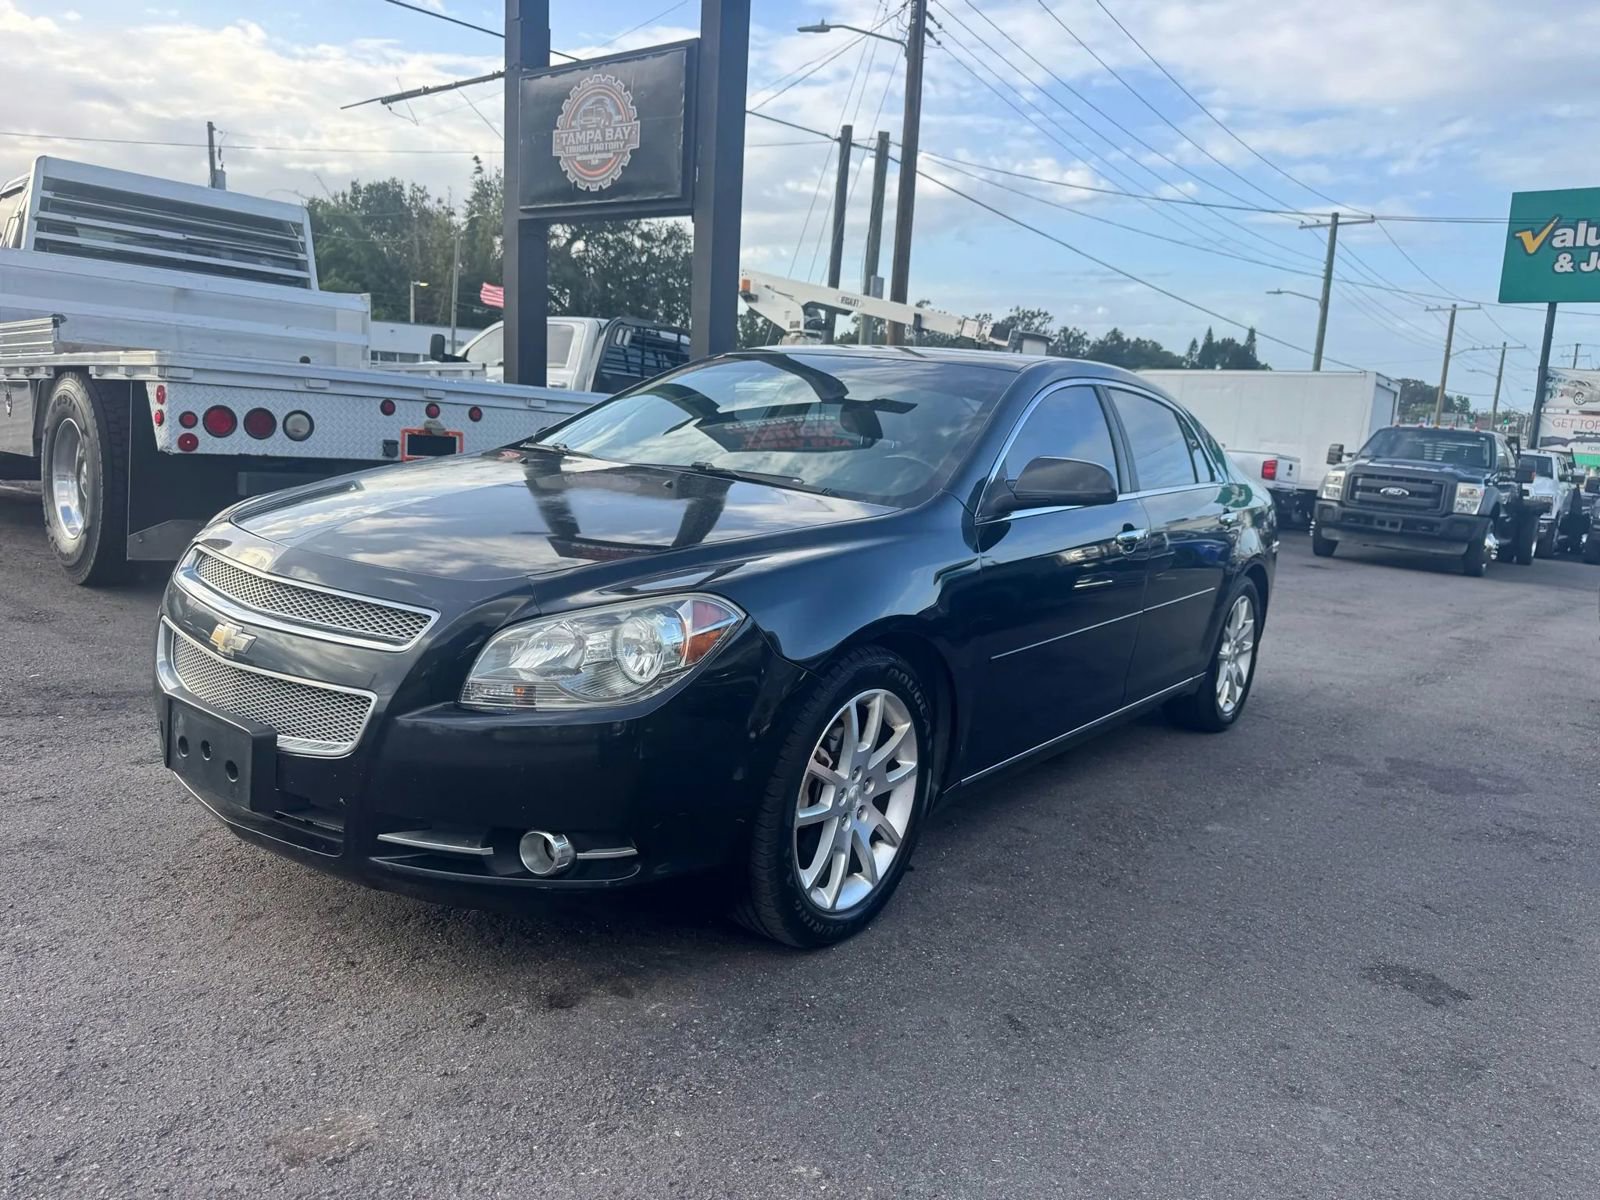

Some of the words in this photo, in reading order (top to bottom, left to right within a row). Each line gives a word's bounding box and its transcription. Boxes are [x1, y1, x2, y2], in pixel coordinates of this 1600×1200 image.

[561, 129, 602, 145] TAMPA
[605, 126, 631, 141] BAY
[1553, 252, 1574, 273] &
[1580, 251, 1600, 272] J
[1552, 417, 1577, 429] GET
